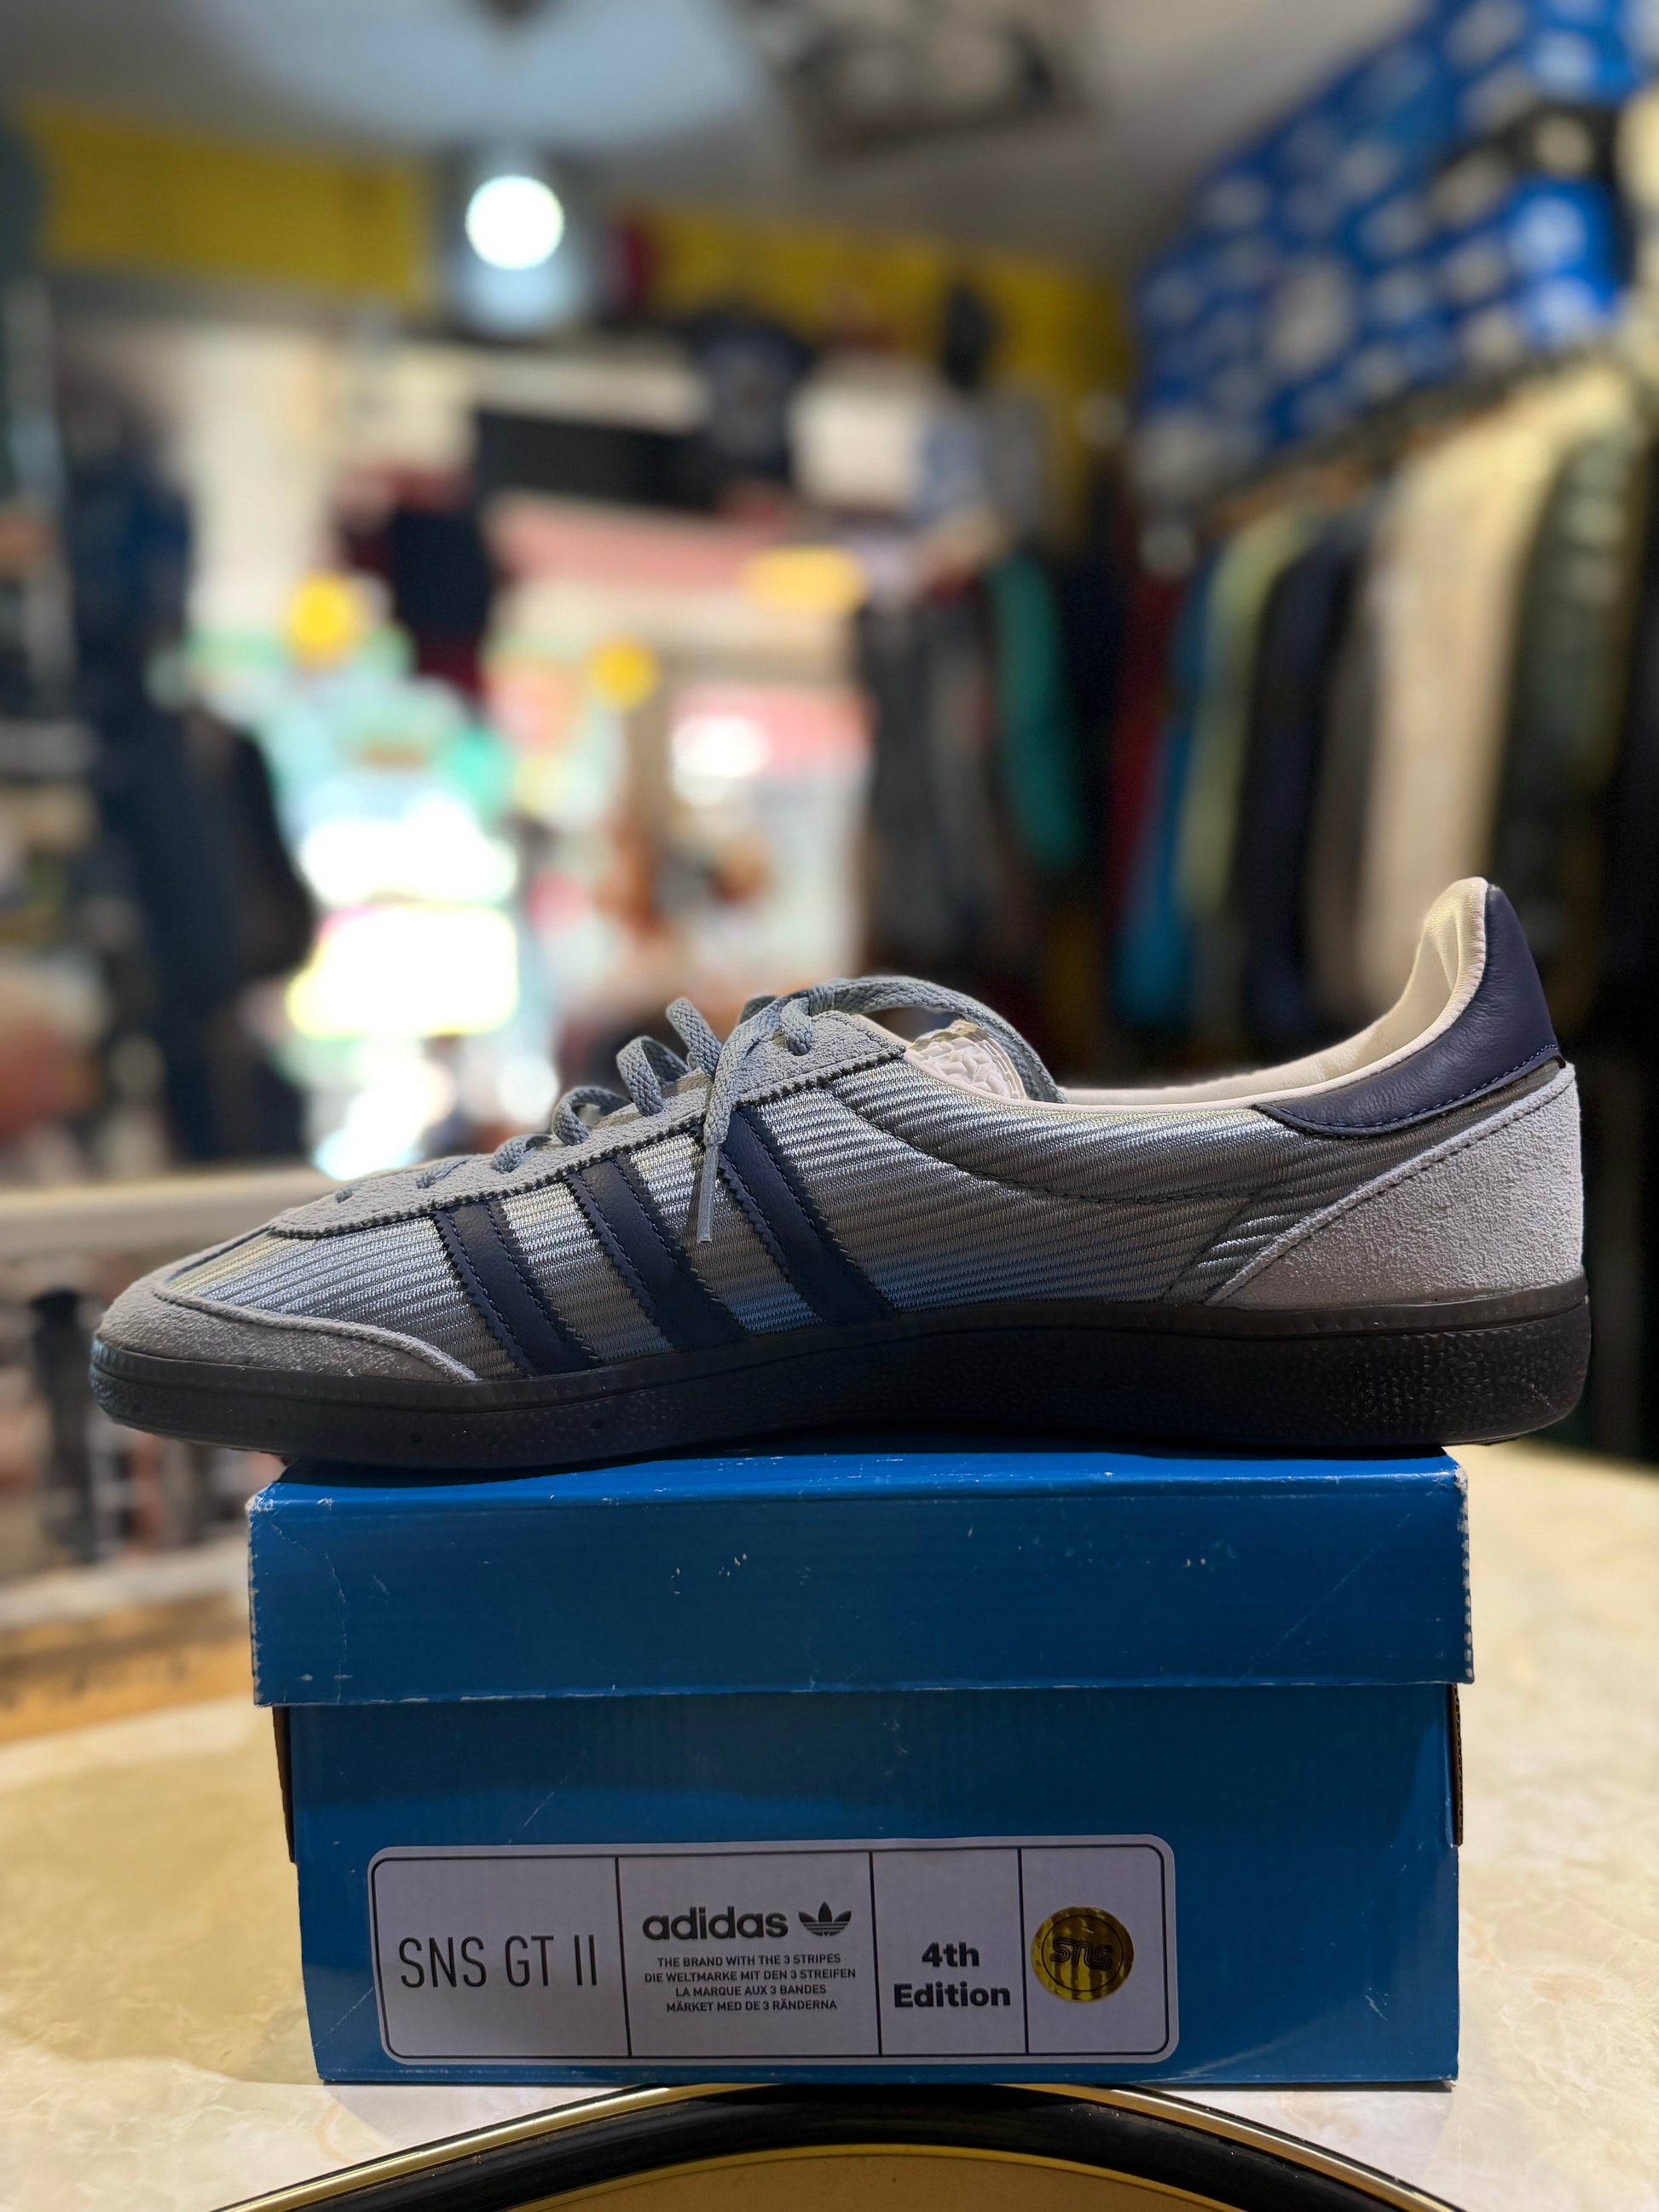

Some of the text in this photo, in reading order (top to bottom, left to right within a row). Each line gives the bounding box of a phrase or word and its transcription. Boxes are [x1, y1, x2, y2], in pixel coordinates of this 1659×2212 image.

[643, 1905, 789, 1941] adidas
[399, 1936, 487, 1988] SNS
[505, 1935, 554, 1987] GT
[657, 1953, 841, 1968] THE BRAND WITH THE 3 STRIPES
[921, 1941, 980, 1967] 4th
[644, 1968, 856, 1984] DIE WELTMARKE MIT DEN 3 STREIFEN
[675, 1984, 827, 1998] LA MARQUE AUX 3 BANDES
[893, 1980, 1012, 2008] Edition
[666, 1997, 838, 2013] MÄRKET MED DE 3 RÄNDERNA
